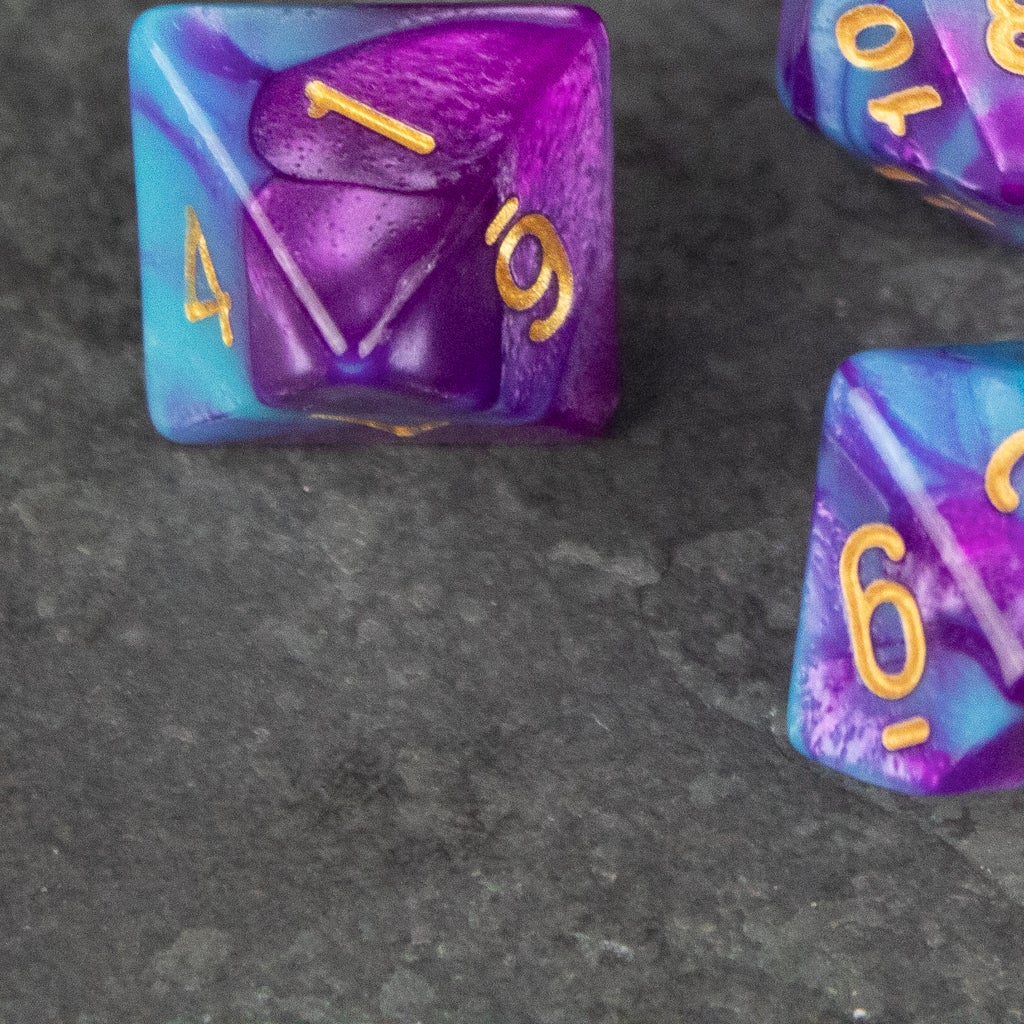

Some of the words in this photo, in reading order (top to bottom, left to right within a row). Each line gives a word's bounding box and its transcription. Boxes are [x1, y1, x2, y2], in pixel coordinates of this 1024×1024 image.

[304, 79, 437, 156] 1
[835, 3, 942, 137] 10
[184, 206, 234, 348] 4
